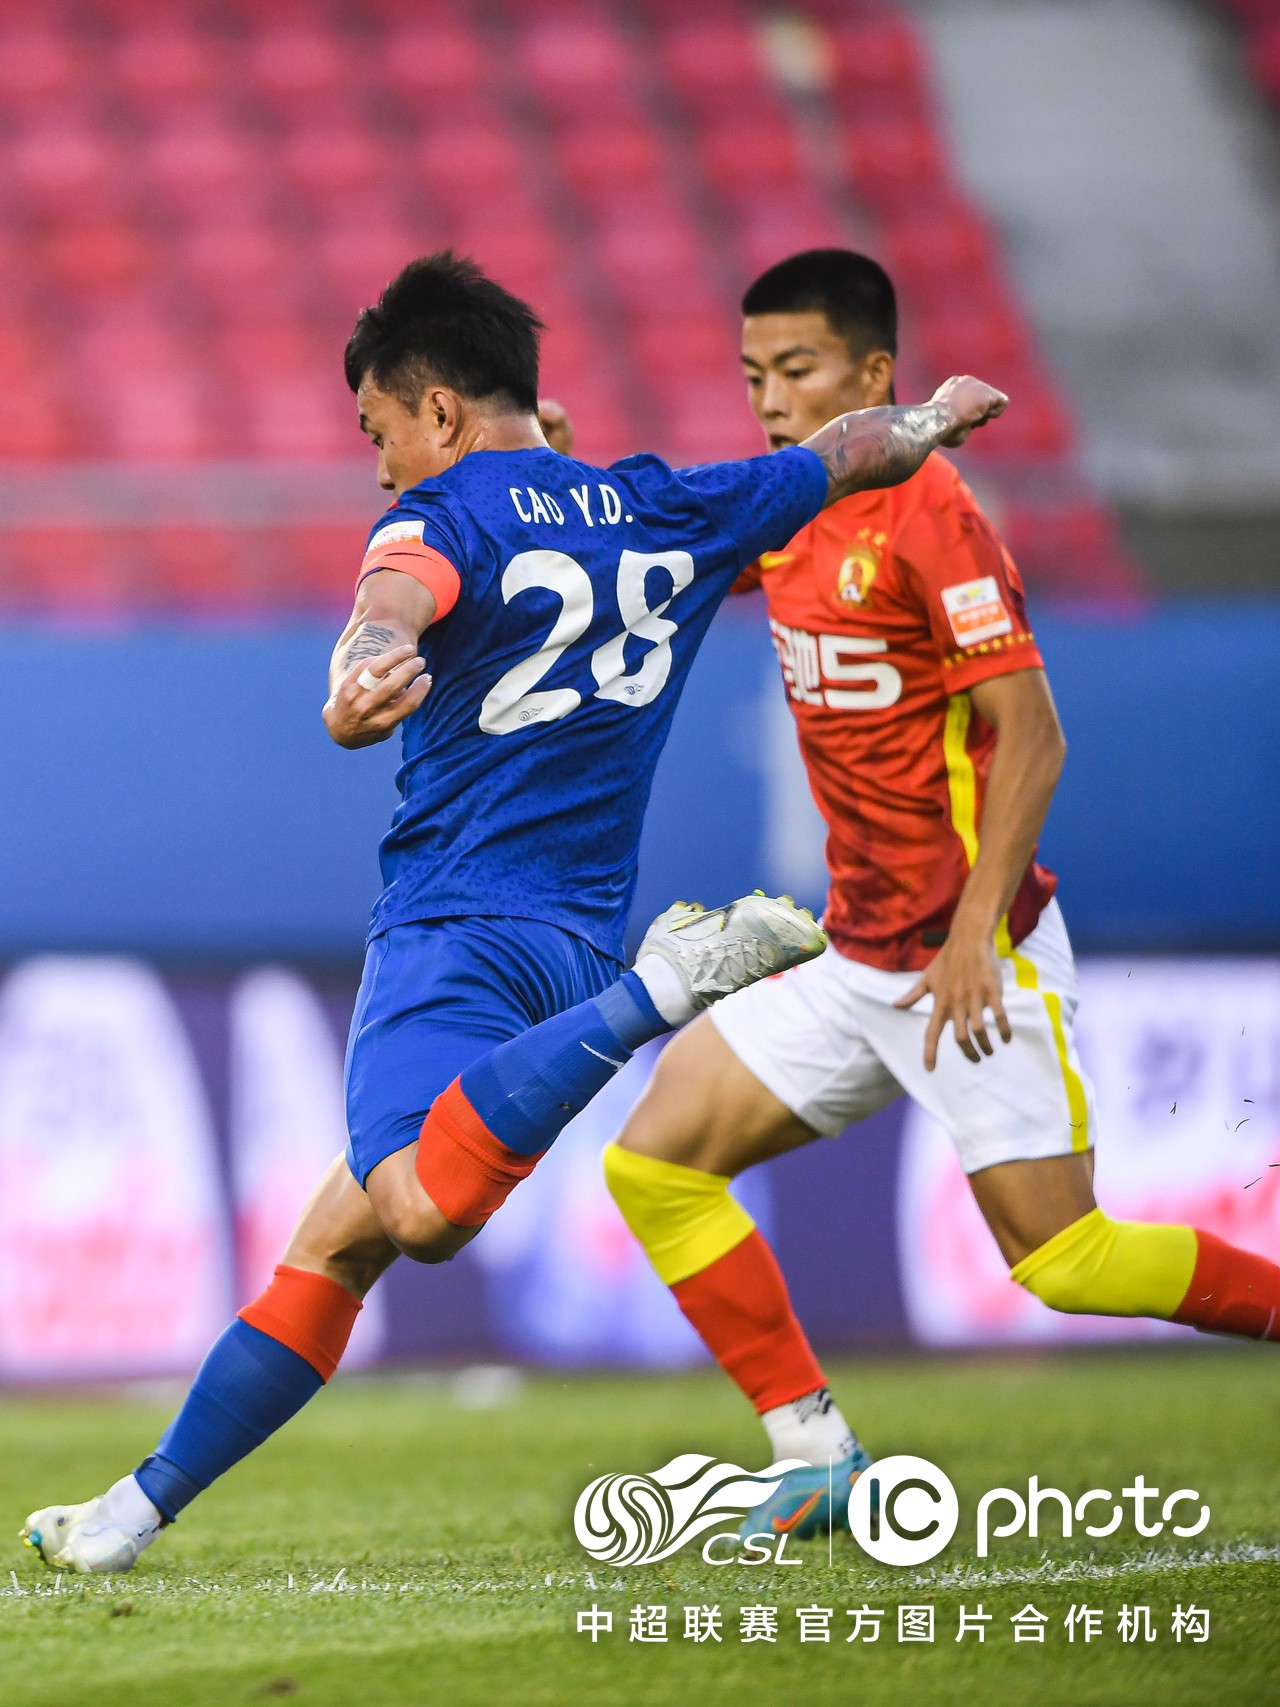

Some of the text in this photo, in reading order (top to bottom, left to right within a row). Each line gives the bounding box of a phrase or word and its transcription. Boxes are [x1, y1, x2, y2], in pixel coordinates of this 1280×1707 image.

[509, 484, 633, 527] CAO Y.D.
[478, 549, 694, 735] 28
